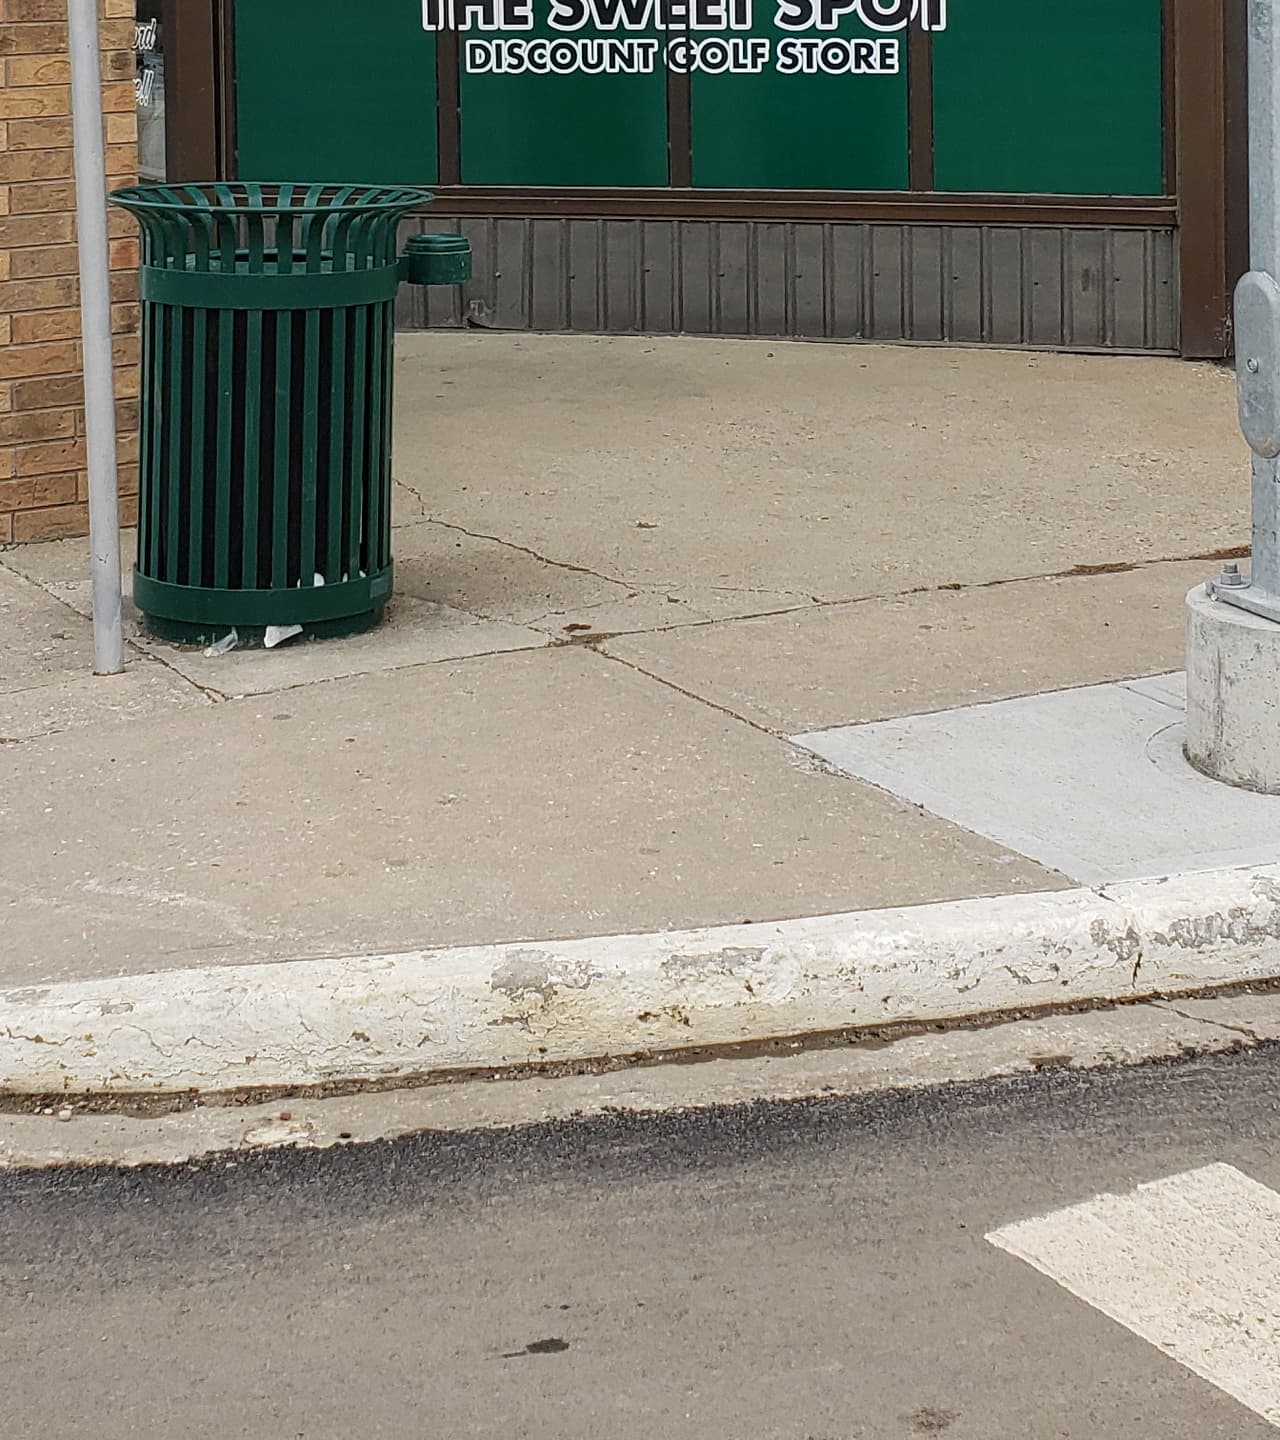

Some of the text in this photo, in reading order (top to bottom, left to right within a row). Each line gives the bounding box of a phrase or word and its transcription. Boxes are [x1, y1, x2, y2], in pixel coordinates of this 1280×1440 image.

[465, 38, 899, 73] DISCOUNT GOLF STORE
